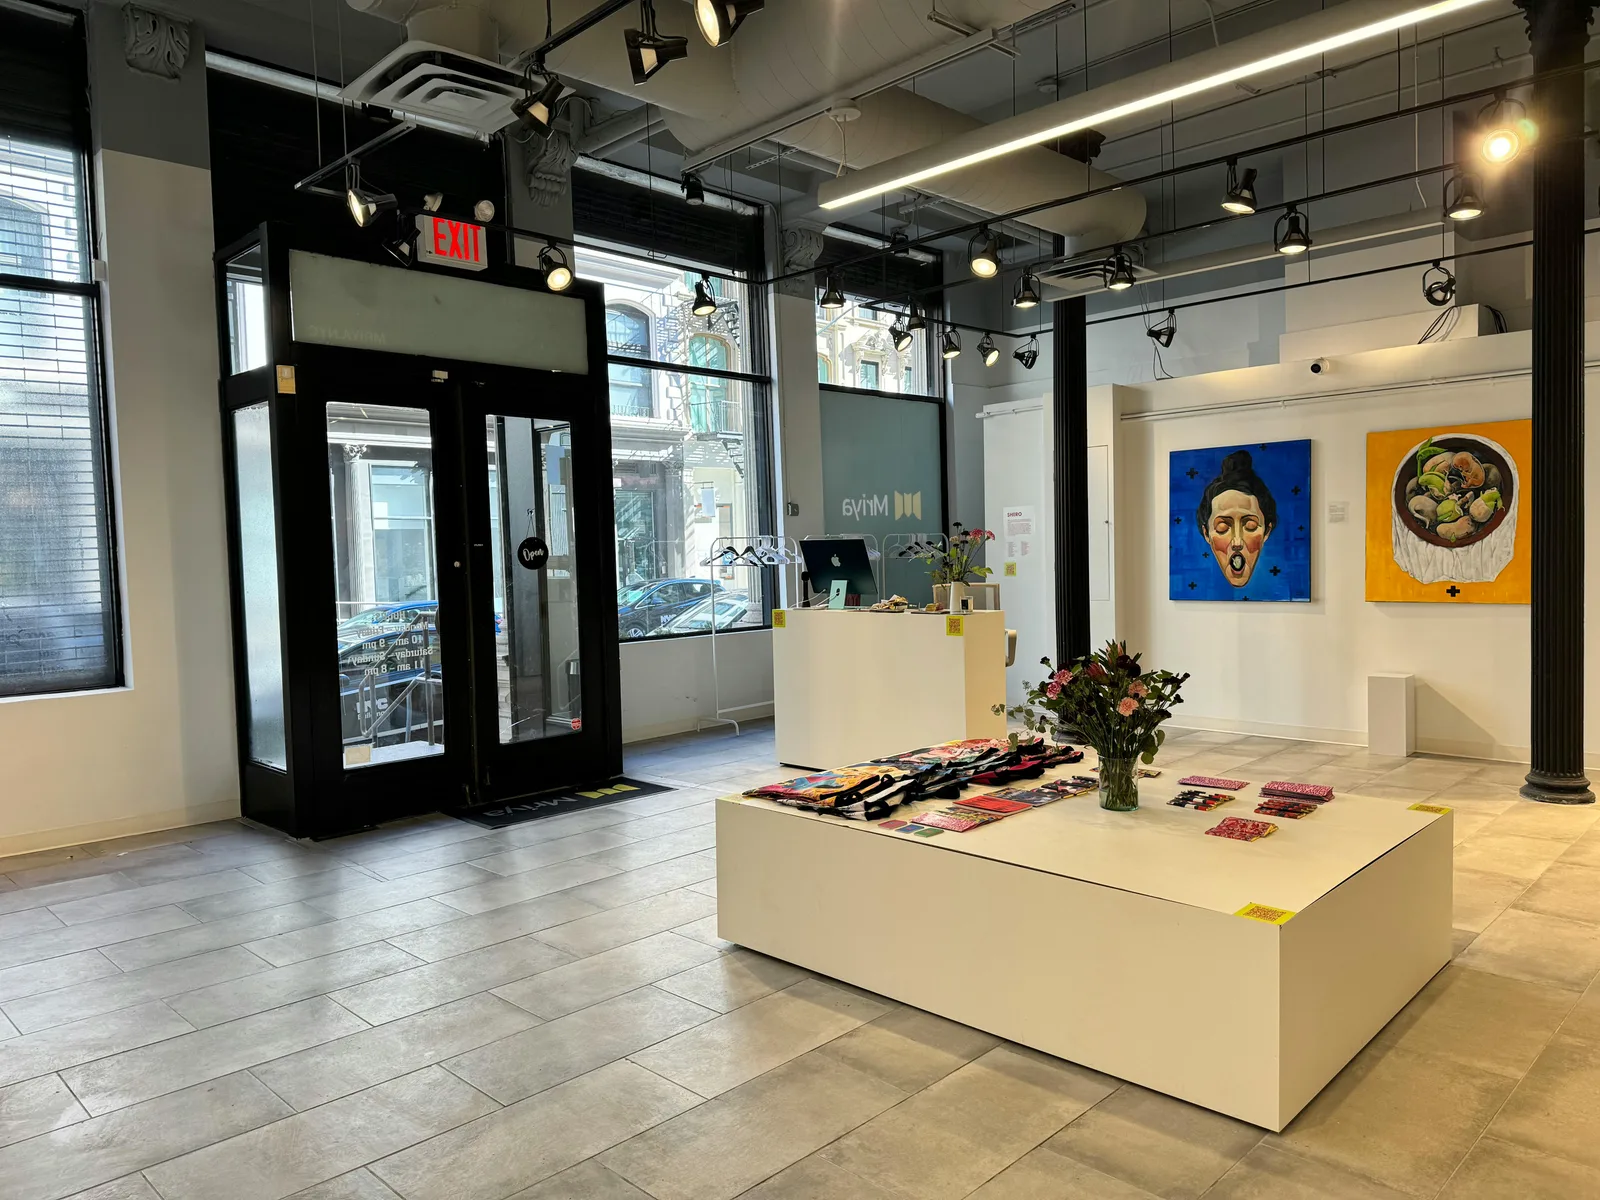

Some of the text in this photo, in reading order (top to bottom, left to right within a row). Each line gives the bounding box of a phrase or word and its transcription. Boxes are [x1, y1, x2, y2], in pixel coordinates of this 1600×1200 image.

[432, 217, 481, 262] EXIT
[522, 548, 544, 561] Open
[482, 796, 579, 818] Mriya
